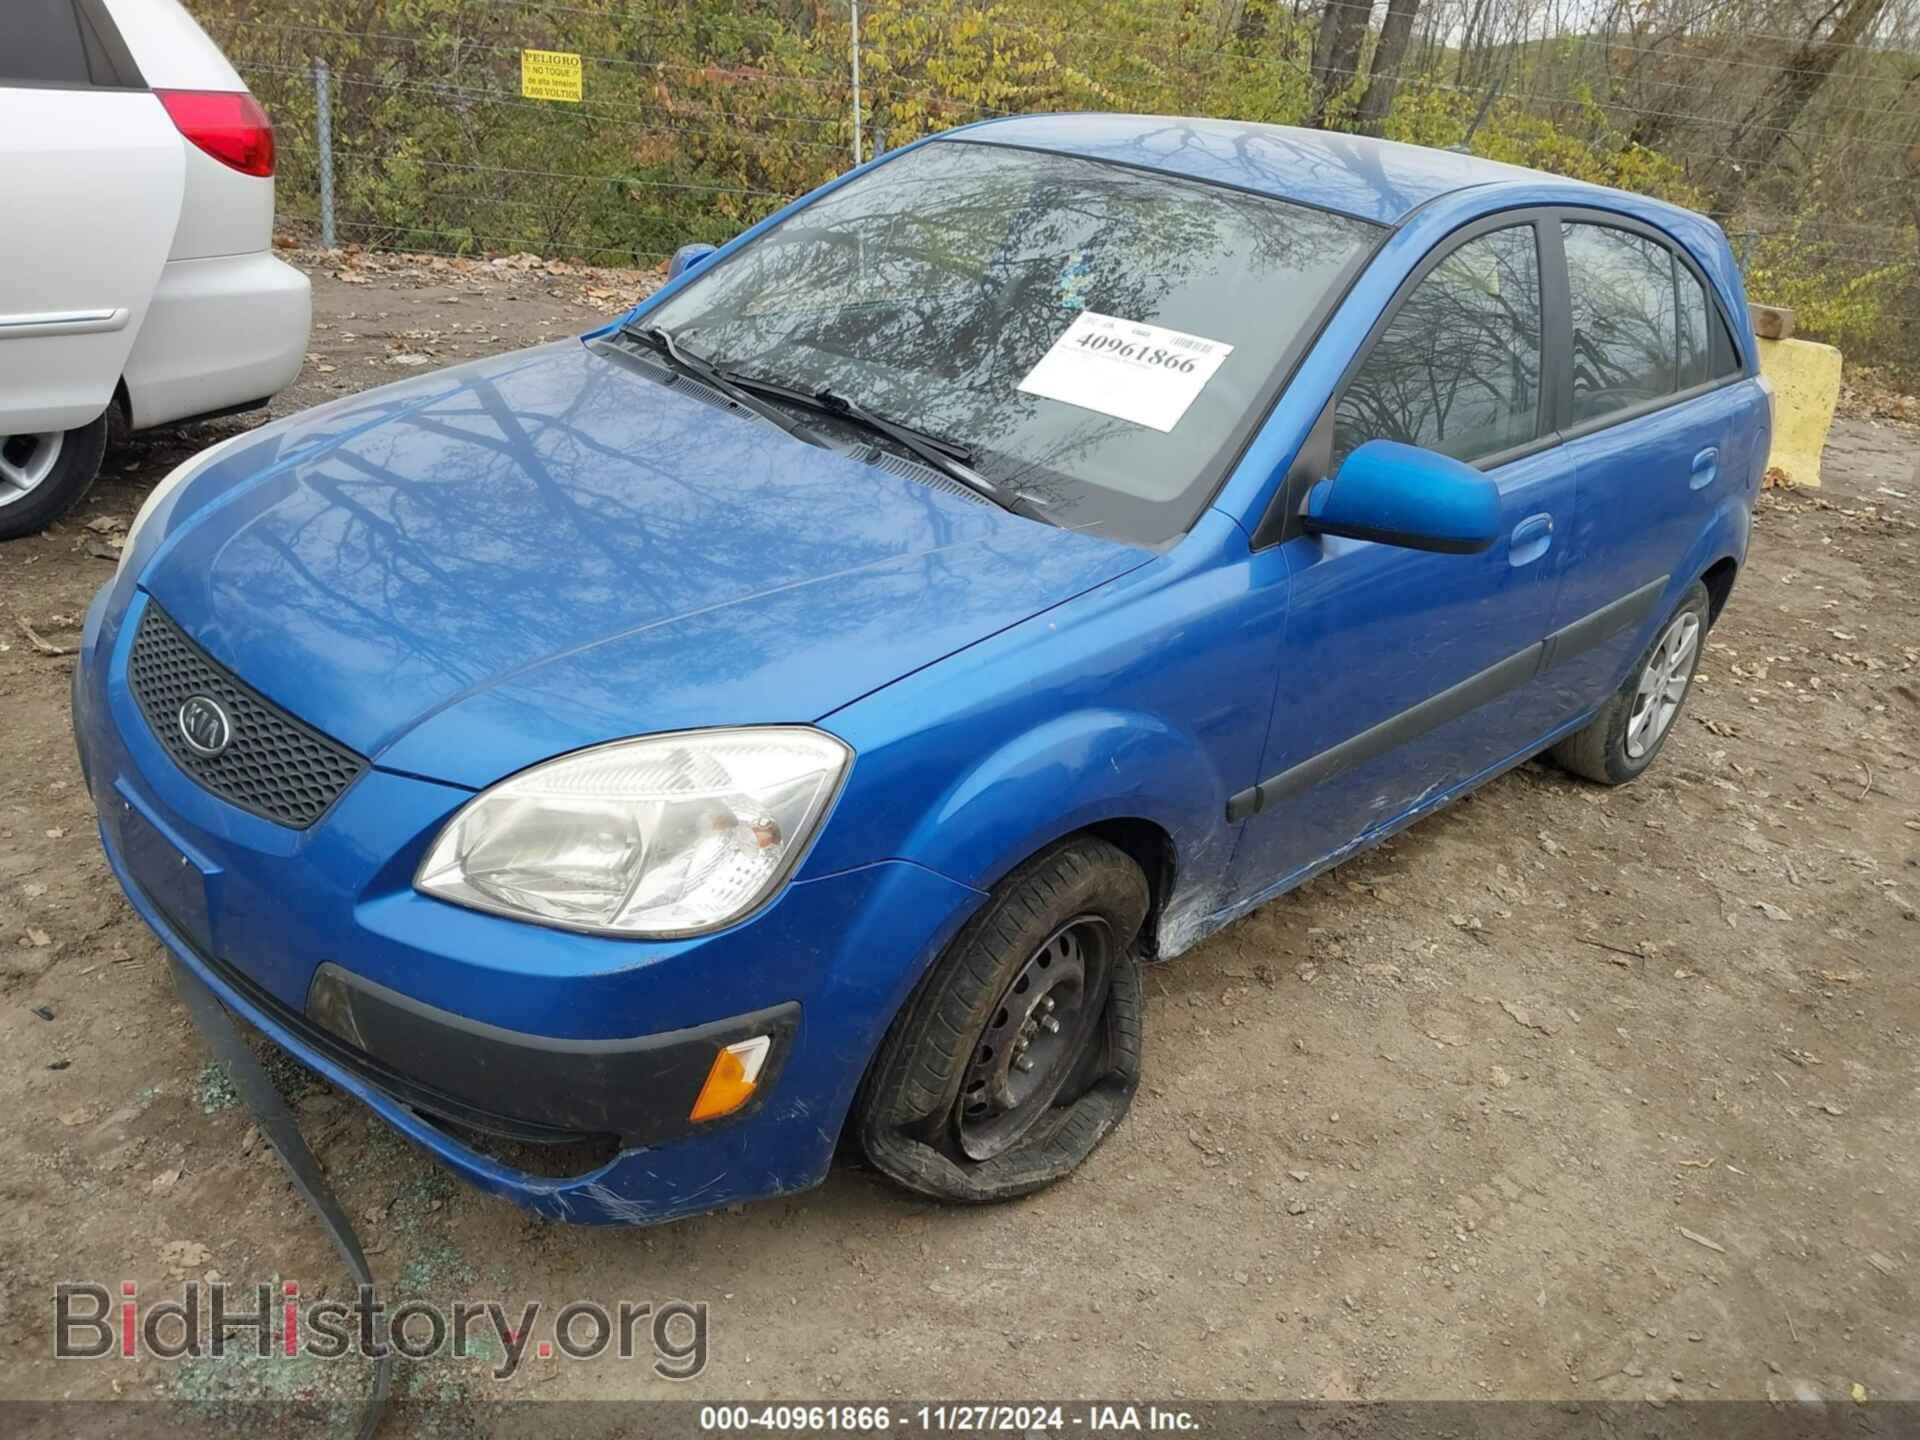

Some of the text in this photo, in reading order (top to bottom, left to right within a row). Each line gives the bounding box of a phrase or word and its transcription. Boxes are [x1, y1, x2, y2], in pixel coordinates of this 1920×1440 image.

[525, 53, 580, 66] PELIGRO
[532, 66, 571, 78] NO TOQUE
[1076, 332, 1200, 374] 40961866
[185, 703, 219, 747] KIA
